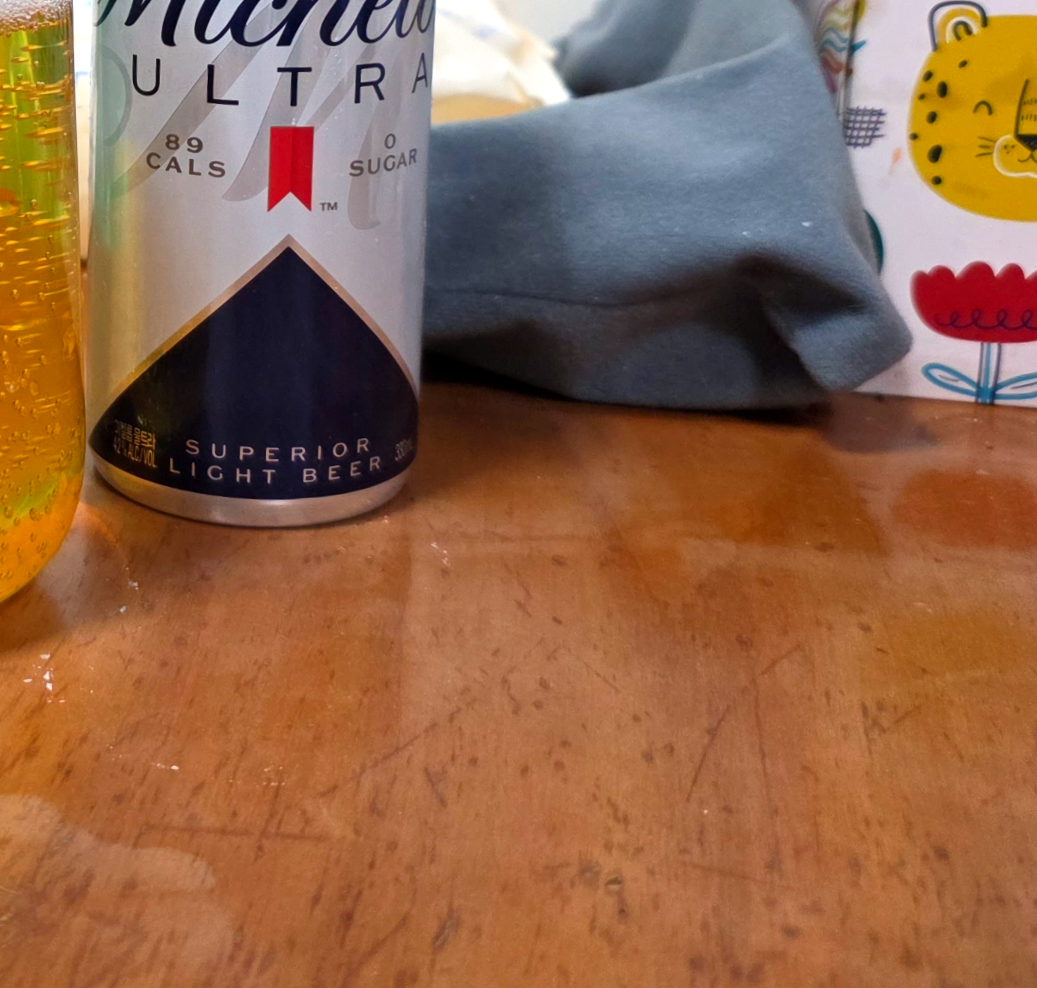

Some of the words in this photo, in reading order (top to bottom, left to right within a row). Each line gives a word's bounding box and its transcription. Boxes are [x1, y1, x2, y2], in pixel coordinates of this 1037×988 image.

[131, 52, 429, 107] ULTRA
[165, 134, 203, 154] 89
[146, 152, 226, 178] CALS
[349, 148, 418, 177] SUGAR
[320, 202, 338, 211] TM
[185, 437, 370, 462] SUPERIOR
[169, 457, 276, 484] LIGHT
[302, 456, 381, 483] BEER
